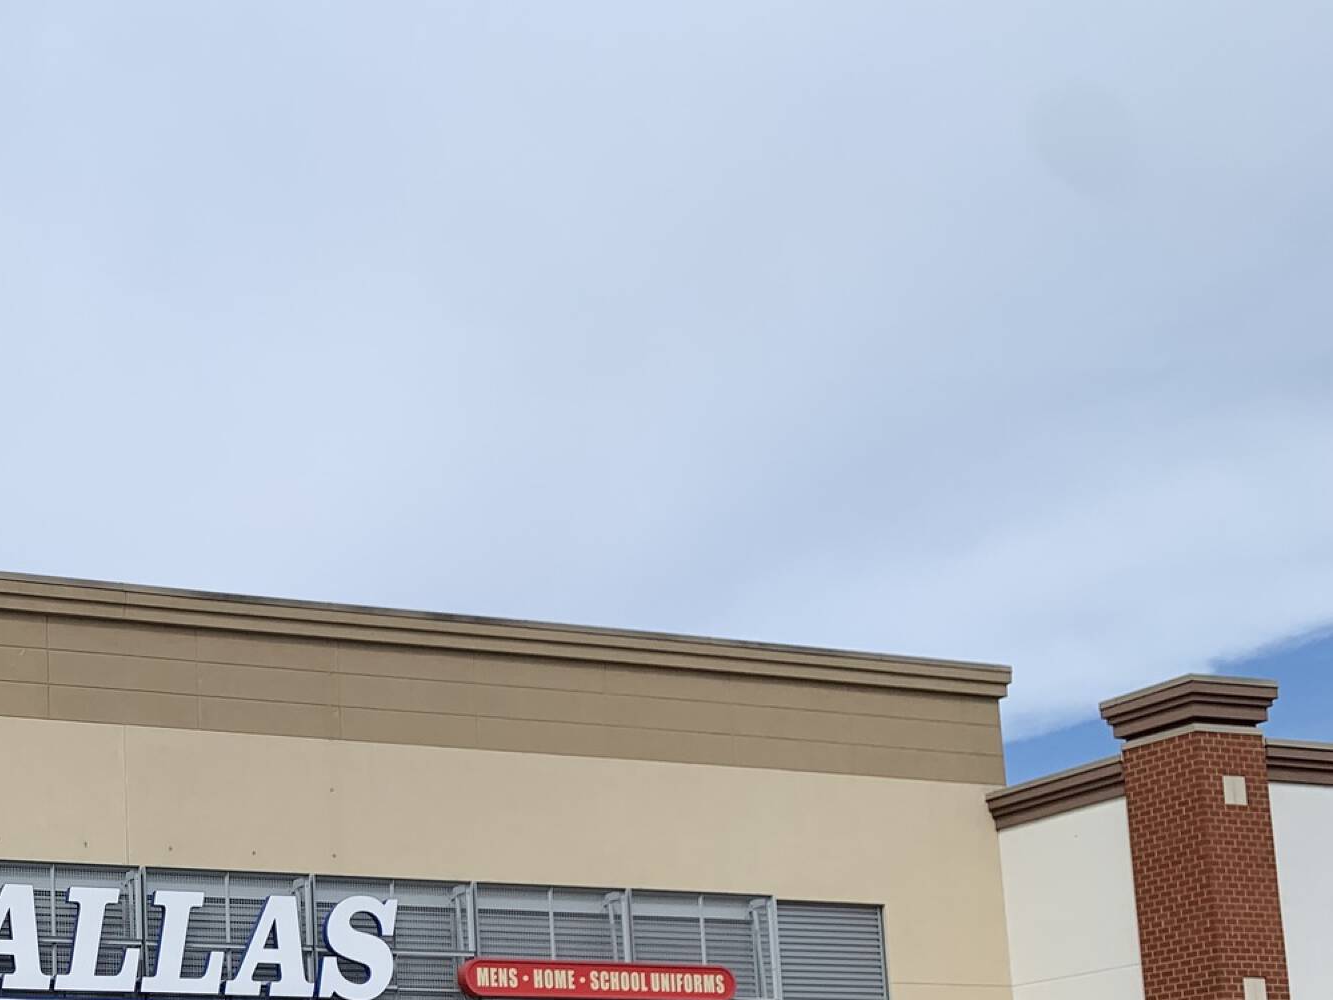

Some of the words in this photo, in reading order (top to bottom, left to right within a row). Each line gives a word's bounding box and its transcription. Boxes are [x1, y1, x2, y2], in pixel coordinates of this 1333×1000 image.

[476, 967, 518, 988] MENS
[533, 969, 575, 990] HOME
[590, 970, 648, 992] SCHOOL
[650, 972, 725, 994] UNIFORMS
